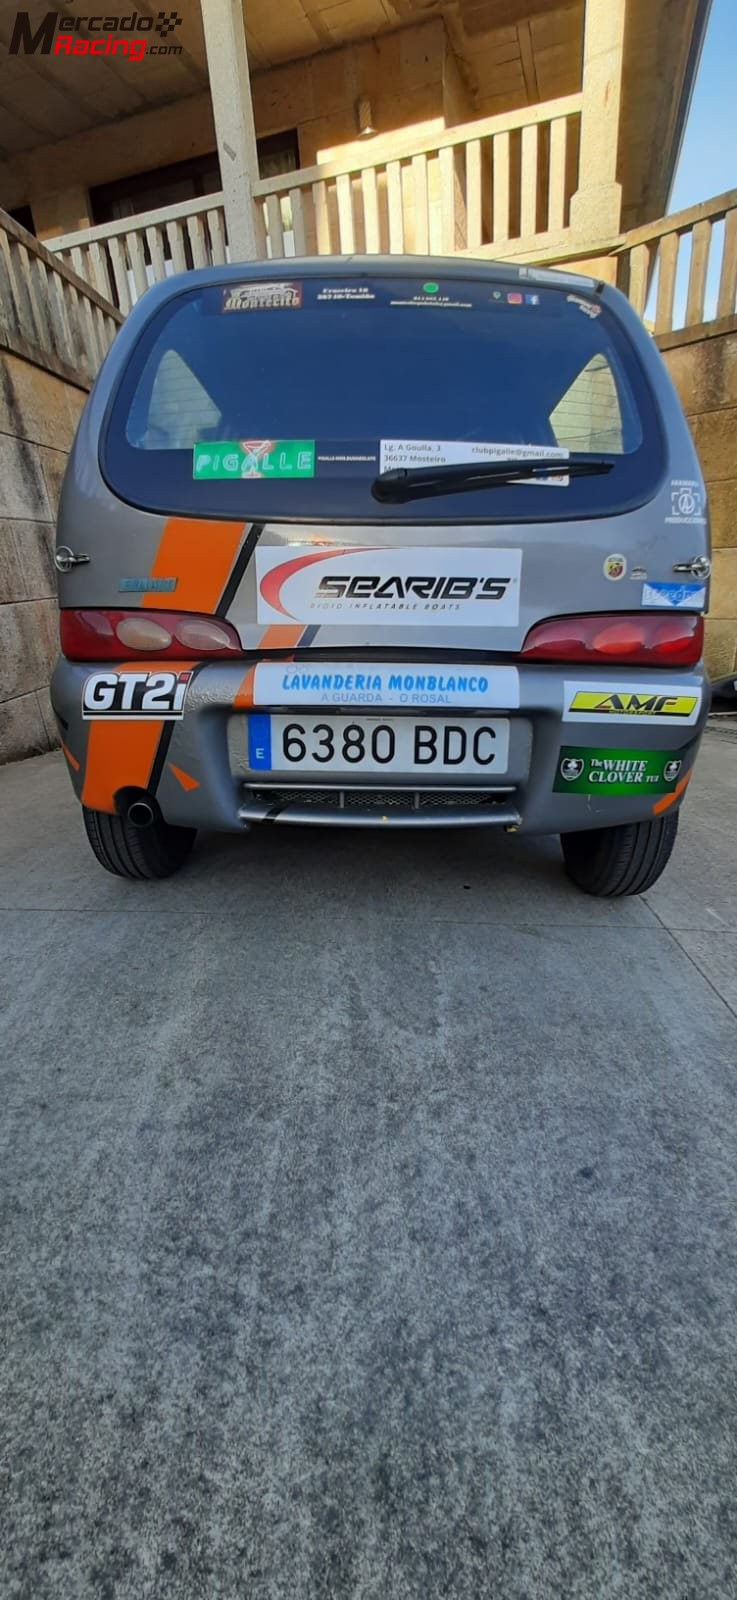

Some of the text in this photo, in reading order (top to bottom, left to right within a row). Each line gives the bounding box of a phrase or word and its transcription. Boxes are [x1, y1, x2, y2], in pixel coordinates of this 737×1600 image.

[195, 451, 313, 472] PIGALLE
[349, 602, 418, 610] INFLATABLE
[424, 602, 461, 611] BOATS
[281, 673, 489, 693] LAVANDERIA MONBLANCO
[84, 672, 191, 711] GT2i
[321, 693, 329, 703] A
[332, 693, 383, 703] GUARDA
[399, 693, 409, 703] O
[410, 693, 452, 704] ROSAL
[593, 694, 679, 712] AMF
[282, 723, 497, 766] 6380 BDC
[255, 748, 265, 759] E
[603, 759, 648, 772] WHITE
[588, 770, 644, 783] CLOVER
